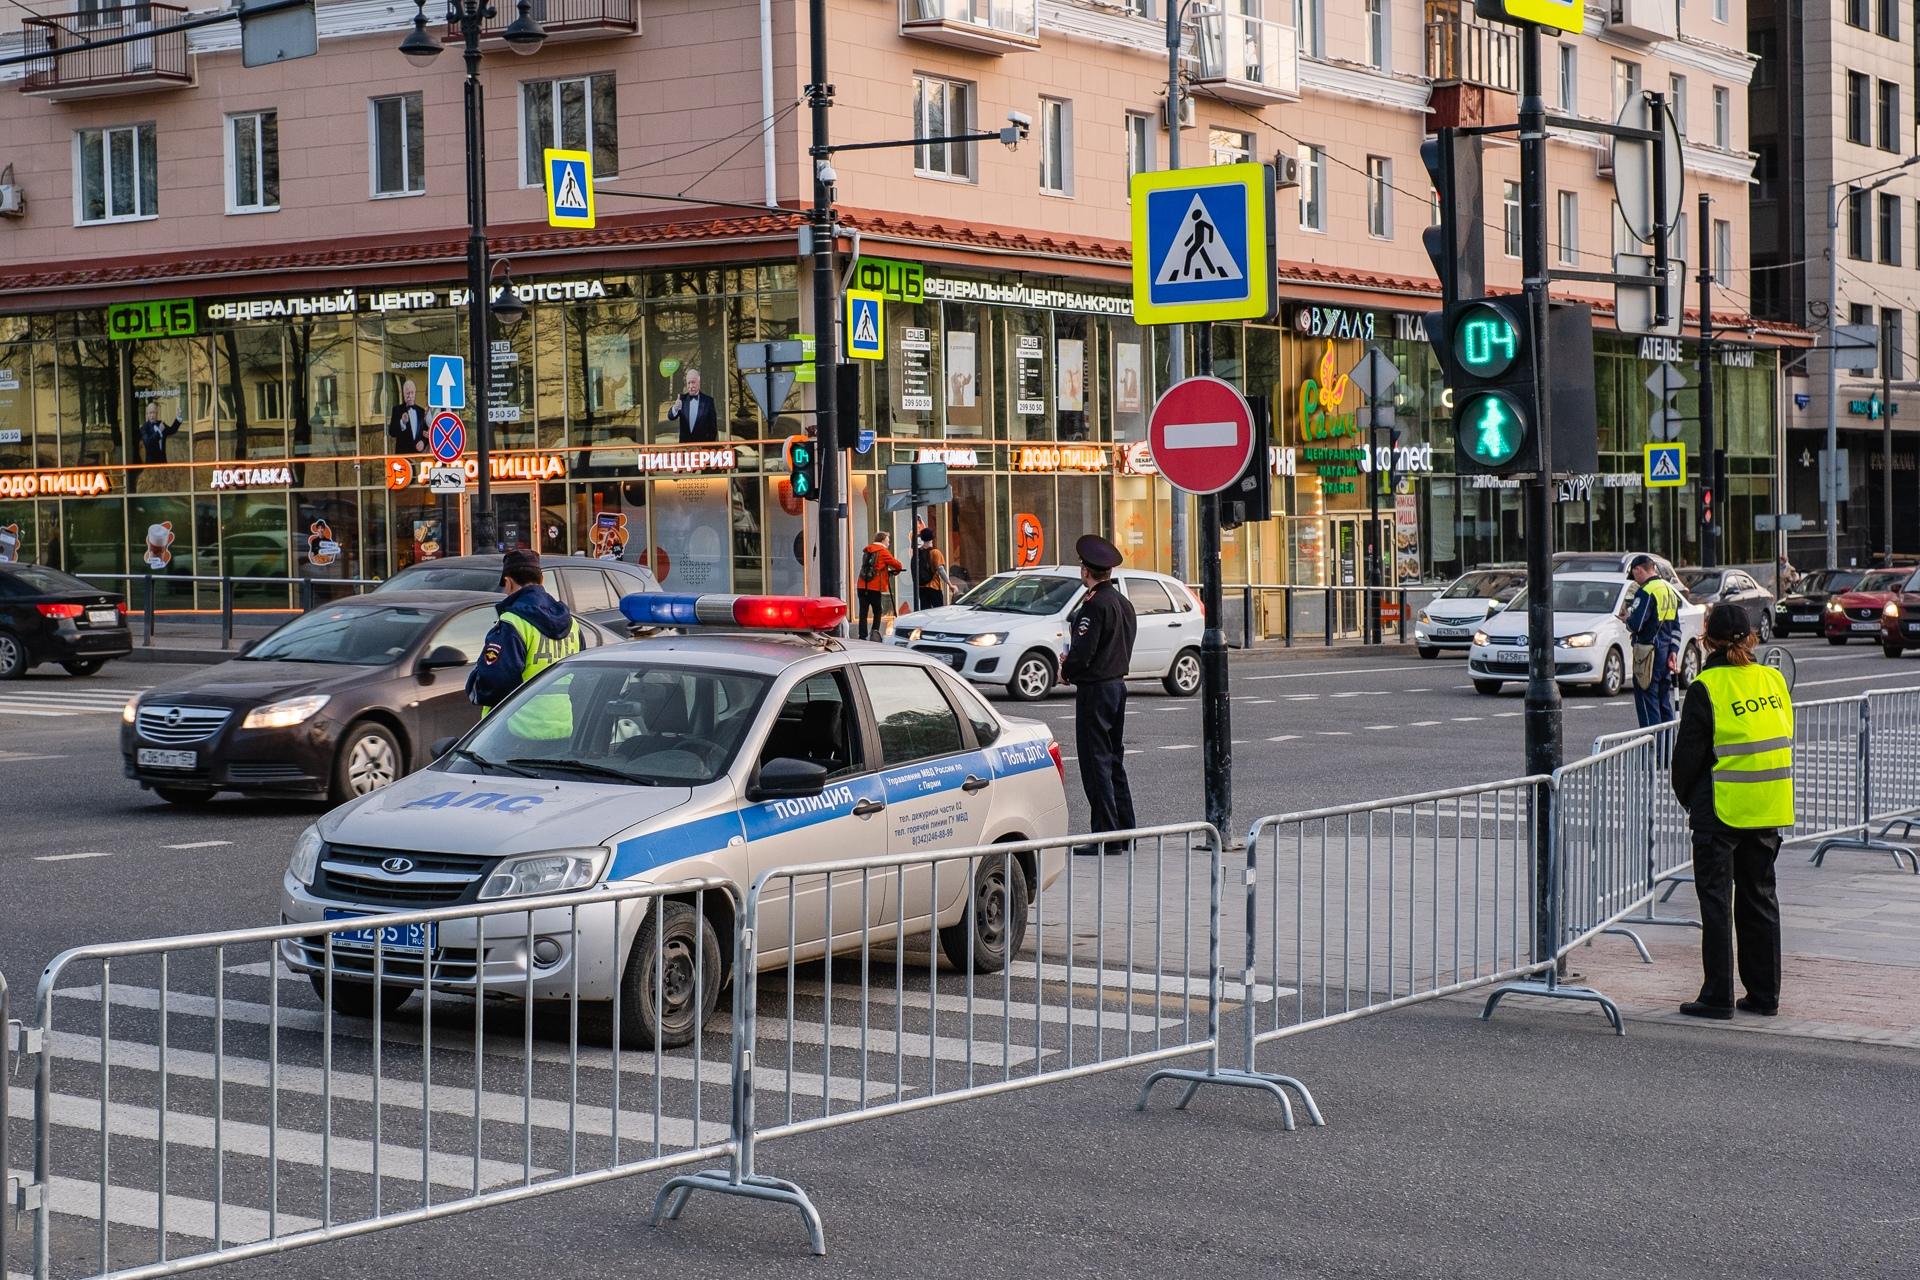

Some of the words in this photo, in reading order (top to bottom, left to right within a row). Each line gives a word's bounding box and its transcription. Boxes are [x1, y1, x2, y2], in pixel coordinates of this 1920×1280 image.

[860, 263, 922, 300] ФЦБ
[208, 289, 356, 321] ФЕДЕРАЛЬНЫЙ
[370, 291, 436, 313] ЦЕНТР
[450, 280, 606, 306] БАКОТСТВА
[112, 303, 192, 337] ФЦБ
[1312, 307, 1374, 340] ВУАЛЯ
[907, 330, 925, 339] ФЦБ
[1466, 321, 1514, 363] 04
[1641, 336, 1683, 362] АТЕЛЬЕ
[1723, 344, 1755, 368] ТКАНИ
[506, 410, 516, 418] 50
[905, 399, 915, 407] 299
[915, 399, 923, 407] 50
[923, 399, 931, 407] 50
[1019, 403, 1028, 411] 299
[418, 459, 478, 484] ДО
[637, 450, 735, 472] ПИЦЦЕРИЯ
[1021, 448, 1060, 471] ДОДО
[1061, 449, 1108, 472] ПИЦЦА
[1319, 466, 1358, 477] МАГАЗИН
[0, 475, 38, 497] ОДО
[40, 472, 110, 496] ПИЦЦА
[211, 467, 292, 489] ДОСТАВКА
[1606, 474, 1642, 487] РЕСТОРАН
[1025, 745, 1046, 764] ДПС
[920, 766, 936, 781] МВД
[935, 765, 955, 777] России
[954, 763, 963, 771] по
[923, 780, 942, 791] Перми
[774, 785, 854, 820] ПОЛИЦИЯ
[899, 814, 911, 823] тел.
[911, 807, 939, 822] дежурной
[939, 803, 955, 814] части
[955, 801, 963, 811] 02
[894, 827, 906, 837] тел.
[907, 821, 930, 836] горячей
[930, 818, 948, 829] линии
[948, 815, 956, 825] ГУ
[955, 812, 969, 823] МВД
